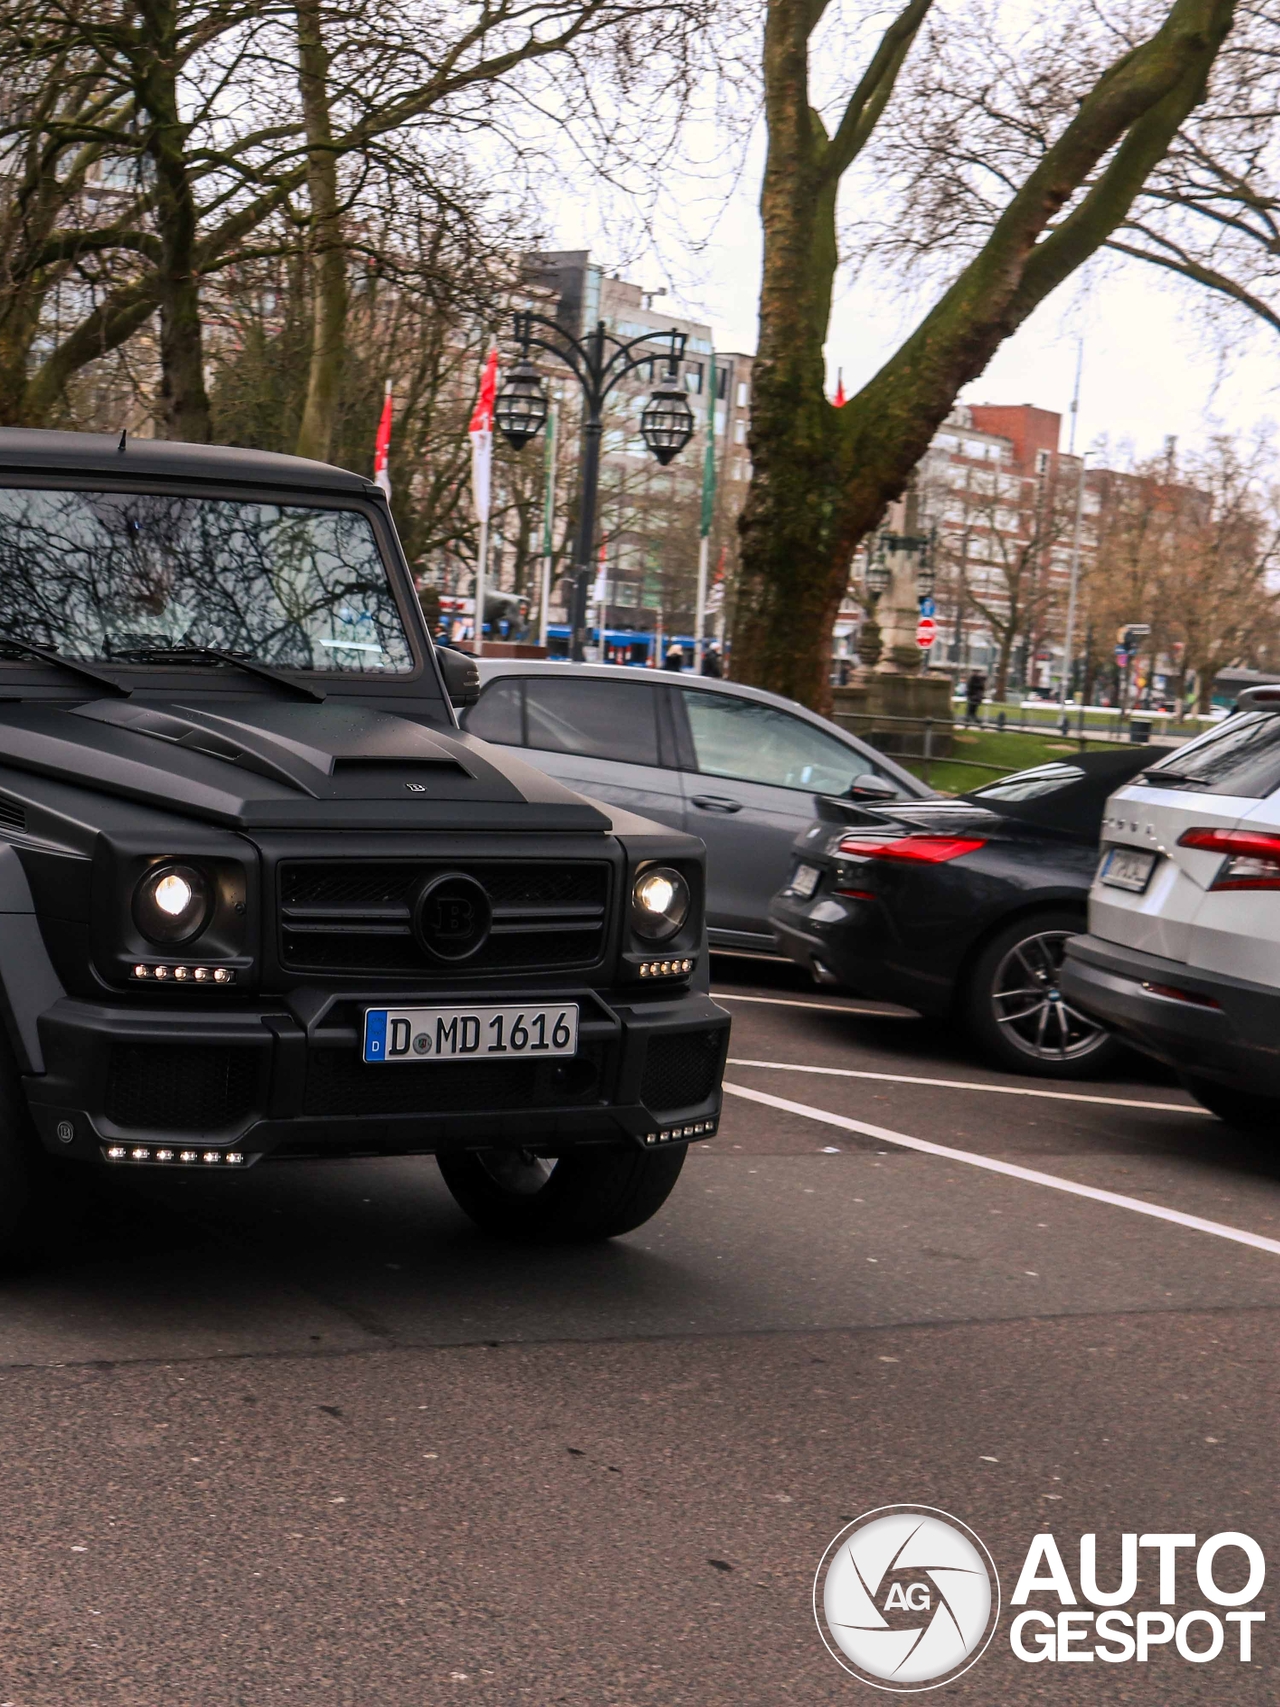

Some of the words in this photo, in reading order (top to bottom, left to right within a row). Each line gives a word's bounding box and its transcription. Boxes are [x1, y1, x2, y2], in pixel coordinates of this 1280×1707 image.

[372, 1041, 380, 1052] D
[389, 1018, 412, 1055] D
[488, 1012, 570, 1051] 1616
